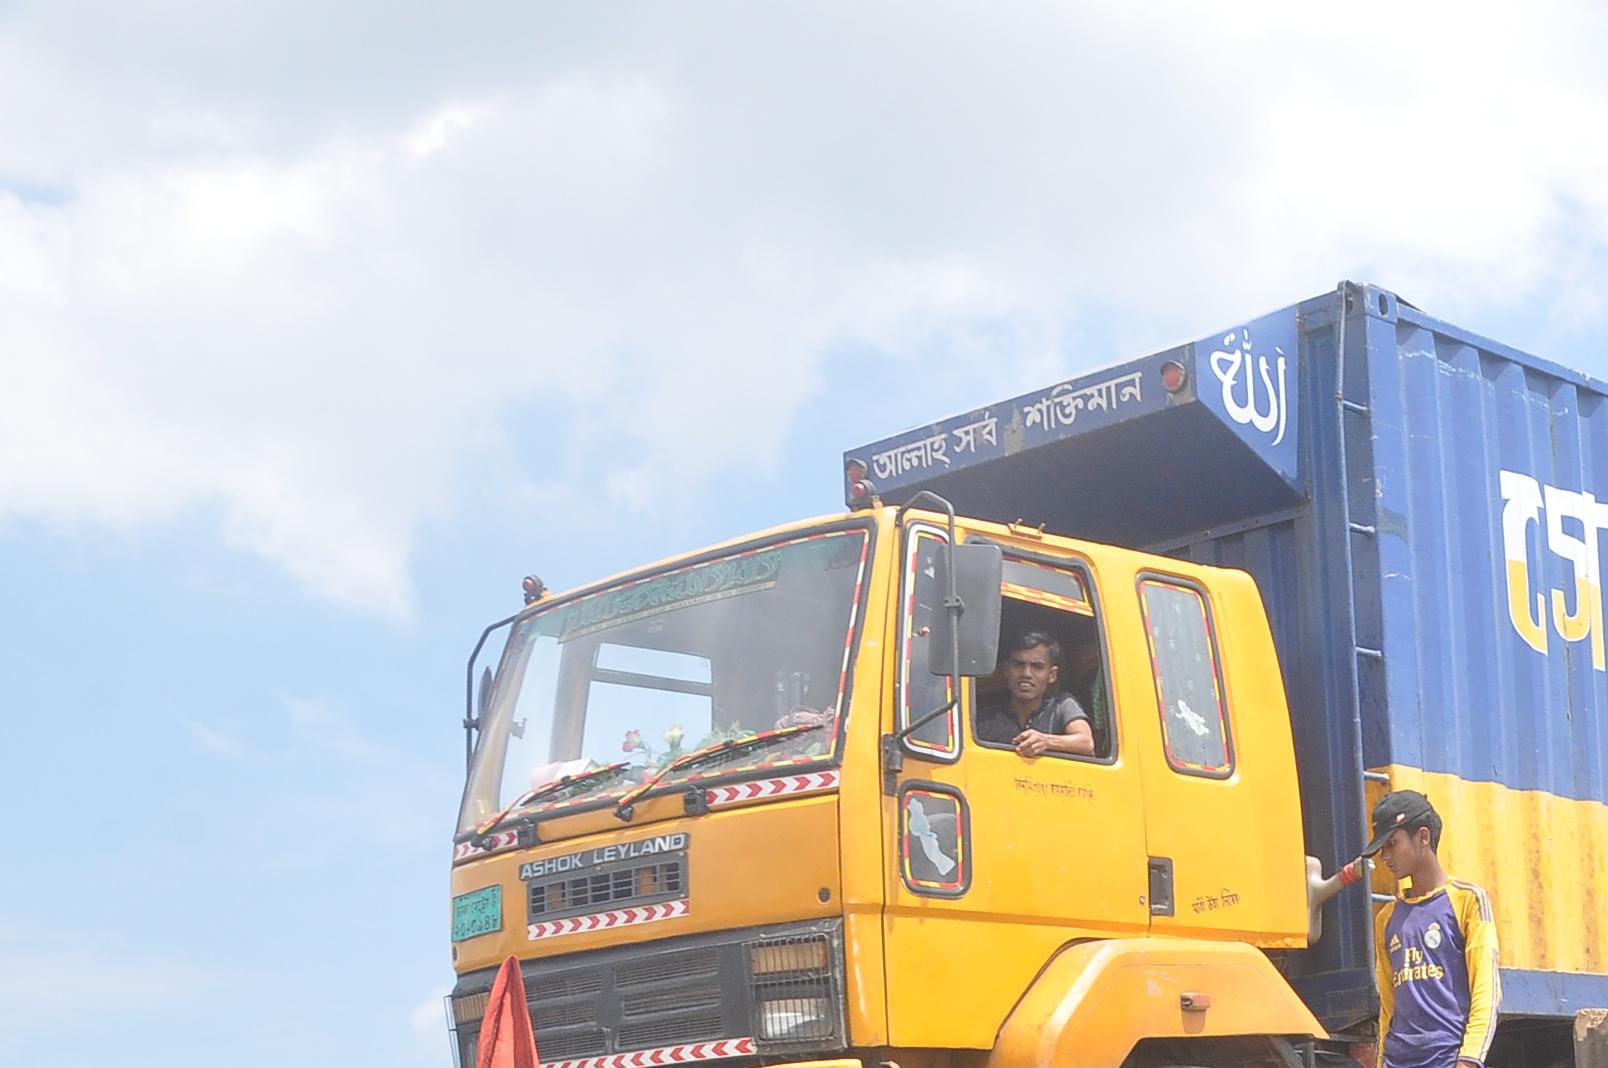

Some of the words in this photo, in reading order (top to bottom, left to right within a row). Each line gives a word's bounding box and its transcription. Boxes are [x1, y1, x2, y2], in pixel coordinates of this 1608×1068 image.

[1023, 371, 1142, 430] শক্তিমান
[520, 853, 583, 879] ASHOK
[593, 834, 686, 864] LEYLAND
[1404, 947, 1423, 965] Fly
